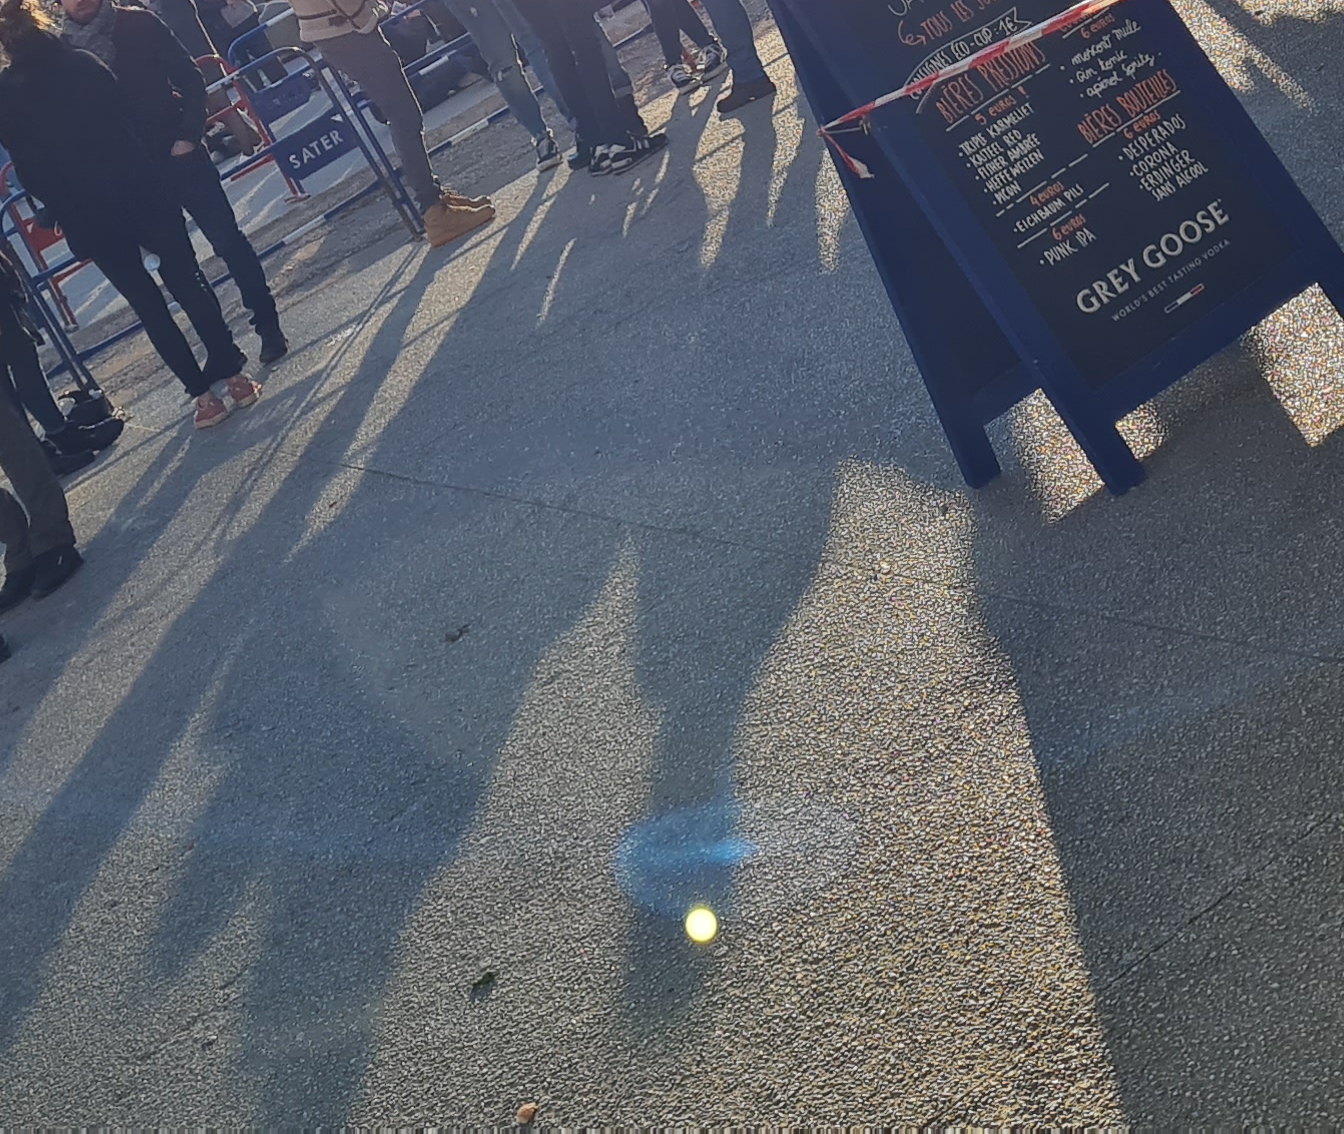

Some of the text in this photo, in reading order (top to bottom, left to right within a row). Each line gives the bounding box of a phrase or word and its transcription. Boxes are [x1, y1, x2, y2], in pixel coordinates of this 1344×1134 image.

[920, 11, 954, 40] TOUS
[950, 0, 974, 23] LES
[1112, 19, 1142, 41] mule
[1098, 50, 1128, 72] tonic
[935, 41, 1046, 124] BIÈRES PRESSIONS
[1077, 68, 1177, 145] BIÈRES BOUTEILLES
[289, 129, 344, 170] SATER
[958, 101, 1035, 156] TRIPLE KARMELIET
[969, 129, 1022, 167] KASTEEL RED
[1122, 113, 1186, 161] DESPERADOS
[977, 132, 1041, 180] FISHER AMBRÉE
[1132, 141, 1179, 177] CORONA
[1140, 149, 1196, 192] ERDINGER
[994, 181, 1023, 205] PICON
[1151, 160, 1209, 202] SANS ALCOOL
[1015, 183, 1085, 234] EICHBAUM PILS
[1043, 227, 1097, 266] PUNK IPA
[1076, 200, 1230, 314] GREY GOOSE
[1111, 238, 1232, 322] WORLD'S BEST TASTING VODKA
